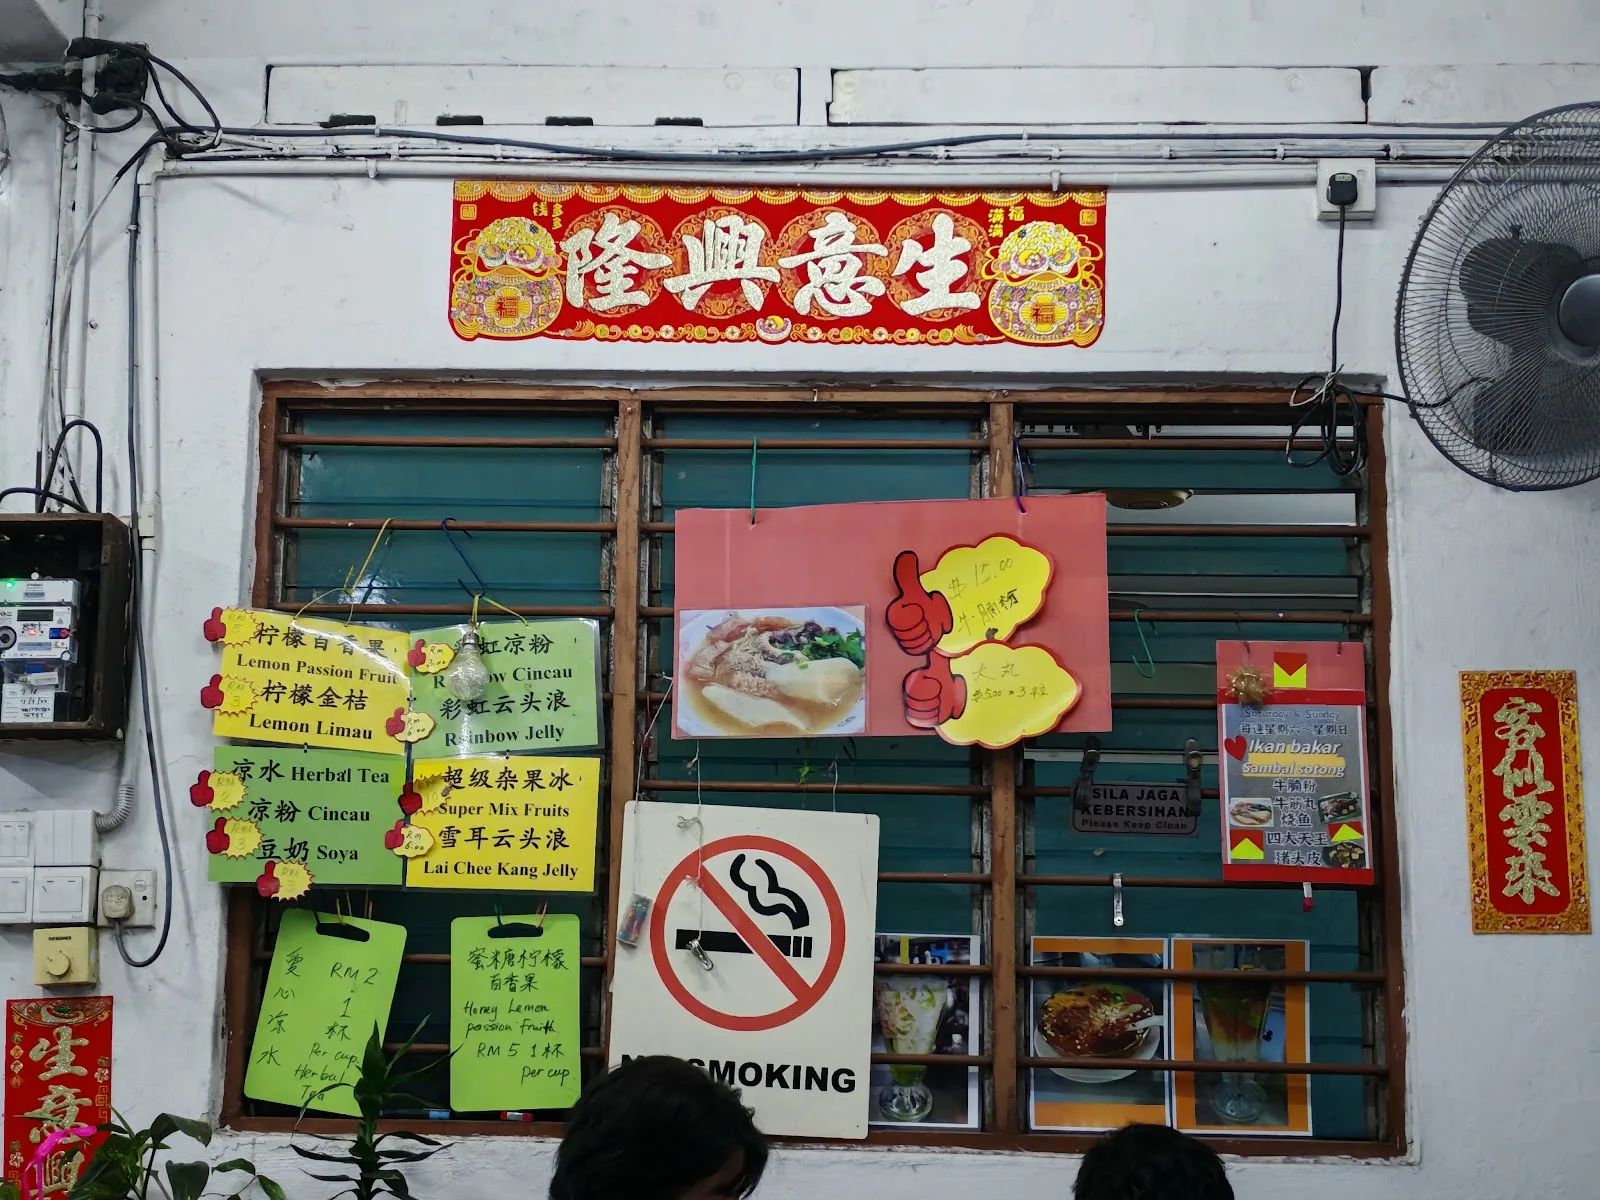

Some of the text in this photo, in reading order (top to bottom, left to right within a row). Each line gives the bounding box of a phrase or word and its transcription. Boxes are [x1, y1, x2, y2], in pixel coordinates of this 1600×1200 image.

[454, 633, 554, 655] 虹凉粉
[237, 653, 399, 685] Lemon Passion Fruit
[512, 667, 573, 682] Cincau
[260, 679, 369, 711] 柠檬金桔
[440, 689, 571, 720] 彩虹云头浪
[249, 713, 373, 740] Lemon Limau
[445, 725, 565, 747] Rinbow Jelly
[1249, 739, 1341, 754] Ikan bakar
[232, 758, 285, 783] 凉水
[291, 766, 390, 783] Herbal Tea
[442, 766, 574, 791] 超级杂果冰
[1242, 762, 1345, 778] Sambal sotong
[1092, 788, 1180, 801] SILA JAGA
[248, 798, 302, 823] 凉粉
[308, 806, 370, 821] Cincau
[438, 802, 570, 818] Super Mix Fruits
[1081, 804, 1190, 818] KEBERSIHAN
[1281, 812, 1312, 827] 烧鱼
[438, 825, 570, 850] 雪耳云头浪
[1266, 831, 1328, 846] 四大天王
[256, 837, 310, 862] 豆奶
[316, 845, 359, 864] Soya
[424, 861, 578, 880] Lai Chee Kang Jelly
[330, 962, 379, 985] RM 2
[463, 998, 550, 1022] Honey Lemon
[325, 1022, 351, 1041] 杯
[477, 1042, 500, 1057] RM
[508, 1043, 520, 1057] 5
[294, 1064, 345, 1083] Herbal
